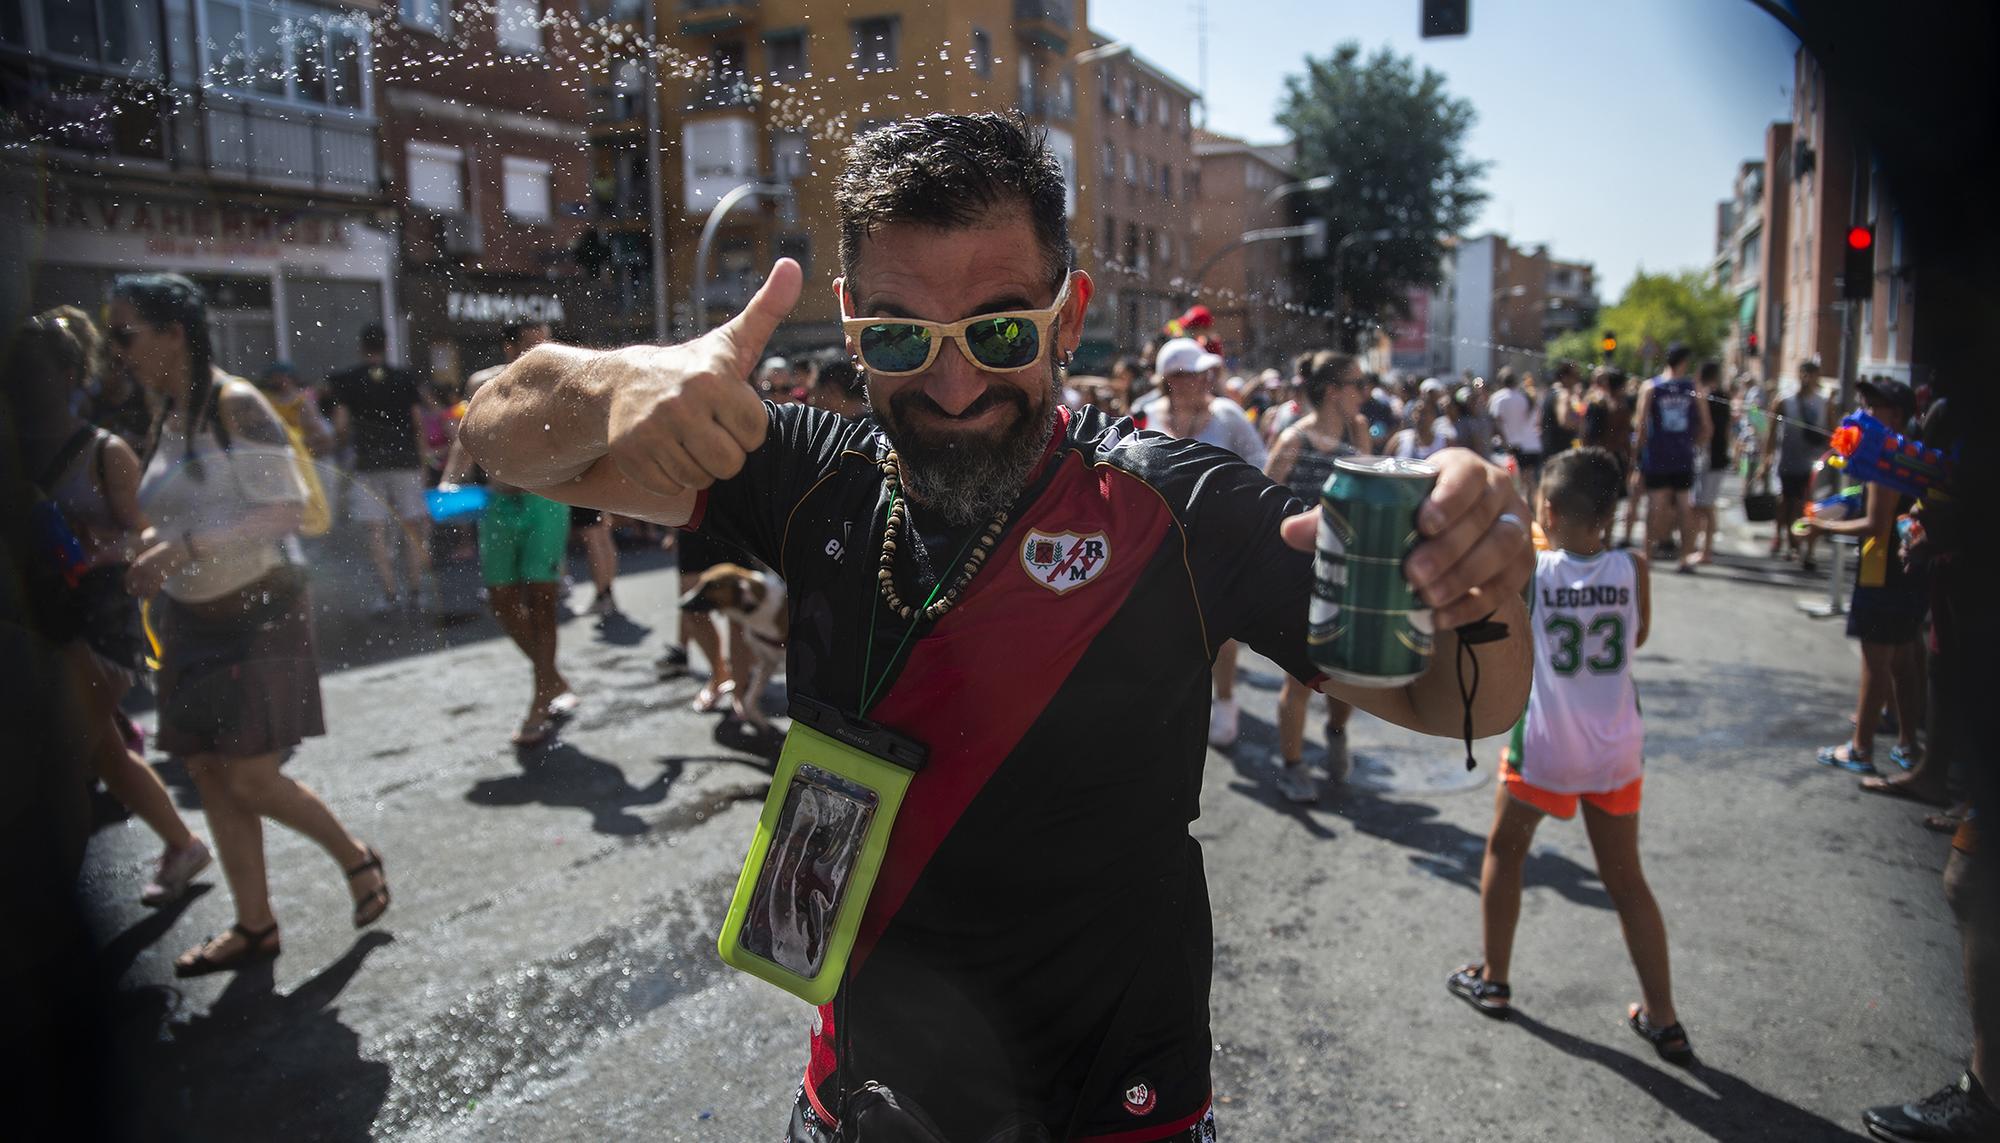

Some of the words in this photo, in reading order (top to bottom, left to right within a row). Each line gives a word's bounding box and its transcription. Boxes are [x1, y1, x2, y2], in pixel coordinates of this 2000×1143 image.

[447, 291, 565, 321] FARMACIA
[1543, 586, 1629, 608] LEGENDS
[1544, 611, 1627, 678] 33
